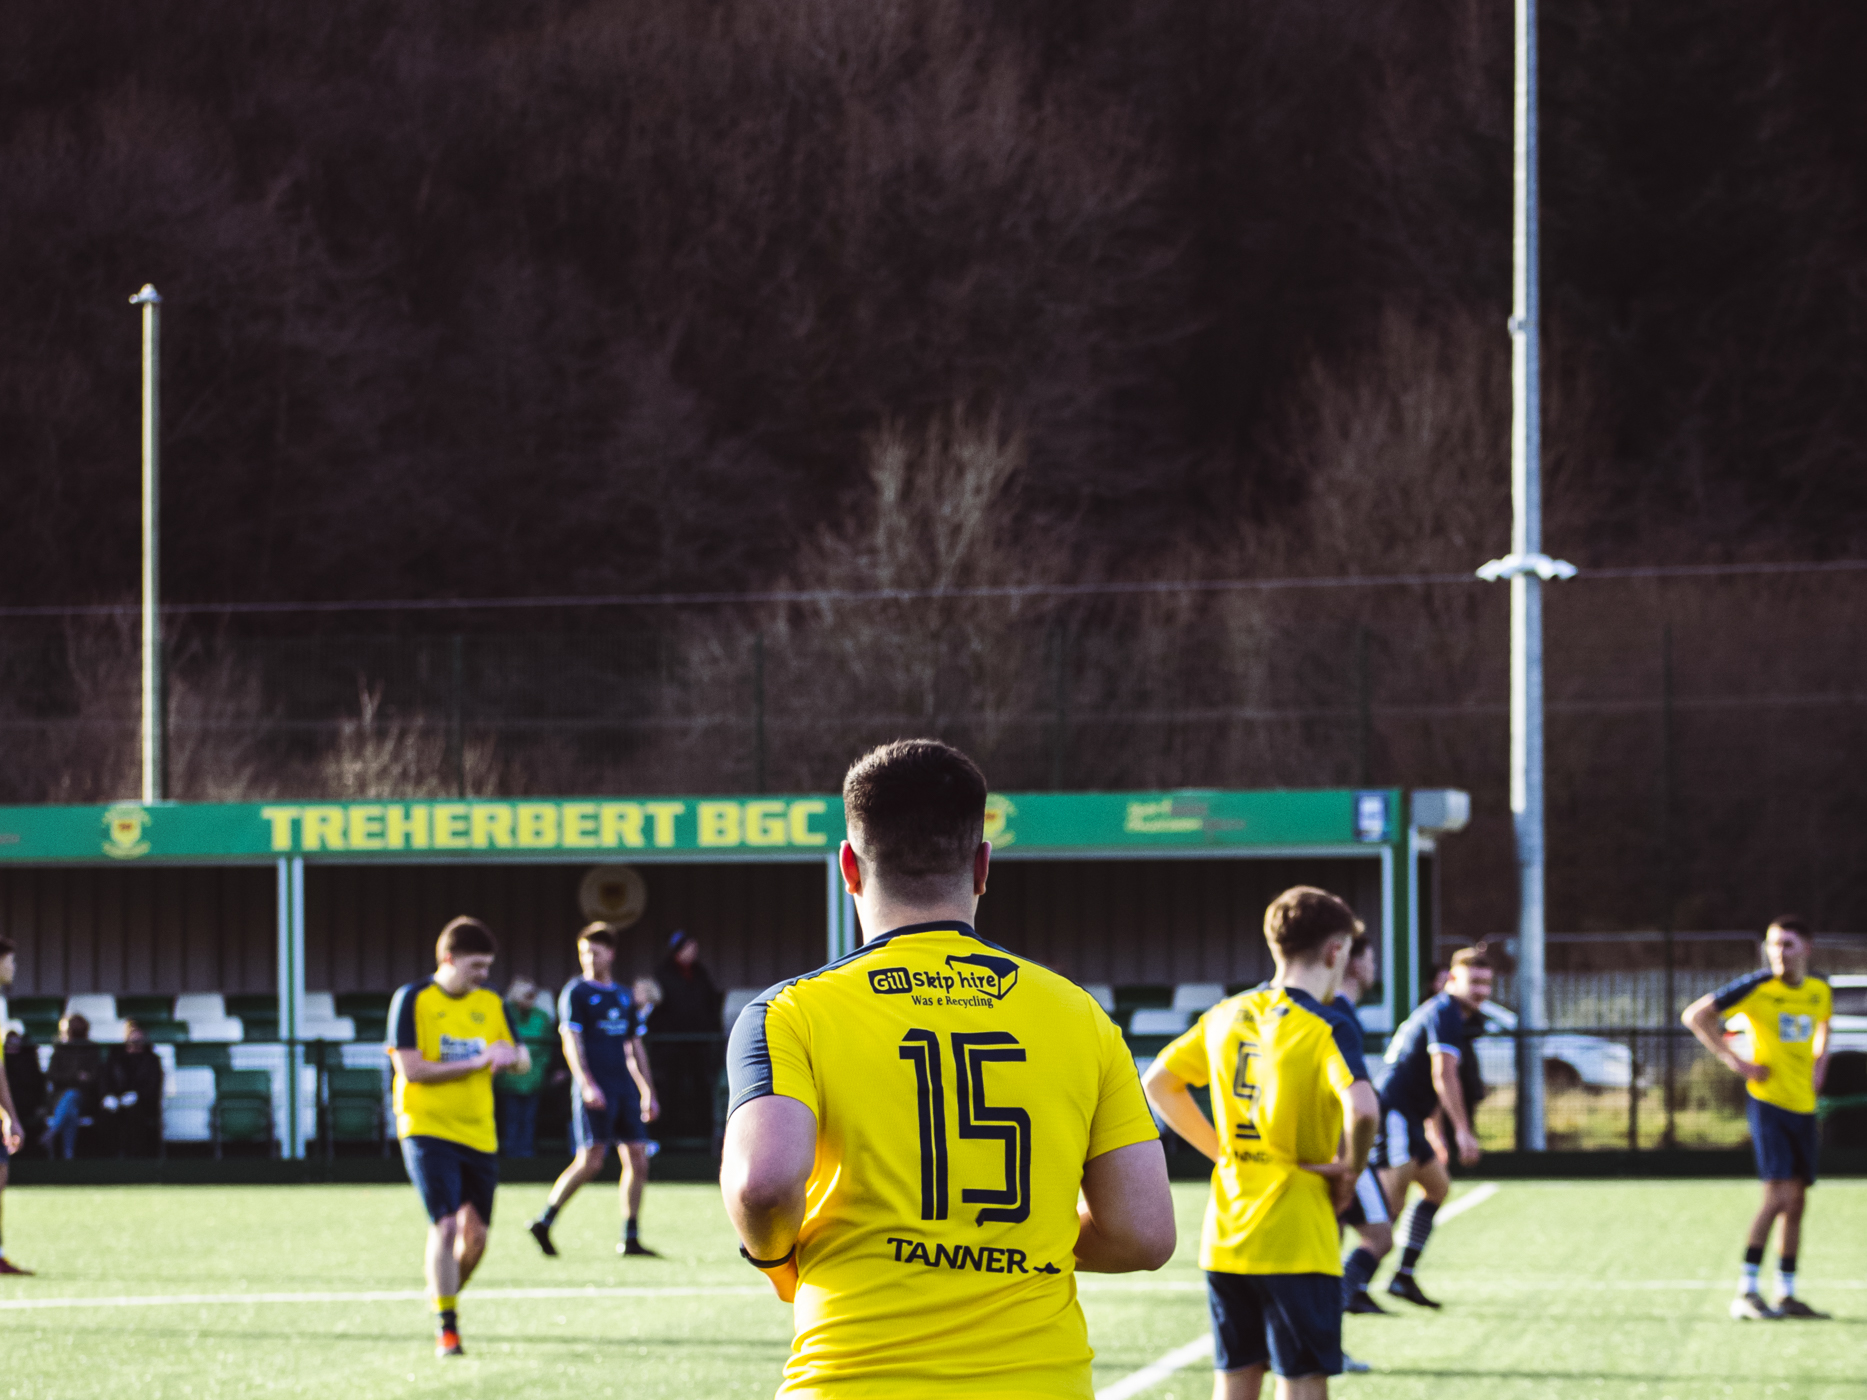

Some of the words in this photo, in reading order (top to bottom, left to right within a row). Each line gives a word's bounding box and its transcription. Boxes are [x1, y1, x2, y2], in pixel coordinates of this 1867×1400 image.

[262, 802, 684, 851] TREHERBERT
[699, 801, 827, 847] BGC
[873, 971, 909, 991] Gill
[912, 971, 955, 993] Skip
[957, 971, 997, 989] hire
[946, 995, 994, 1008] Recycling
[899, 1028, 1032, 1226] 15
[886, 1237, 1029, 1274] TANNER
